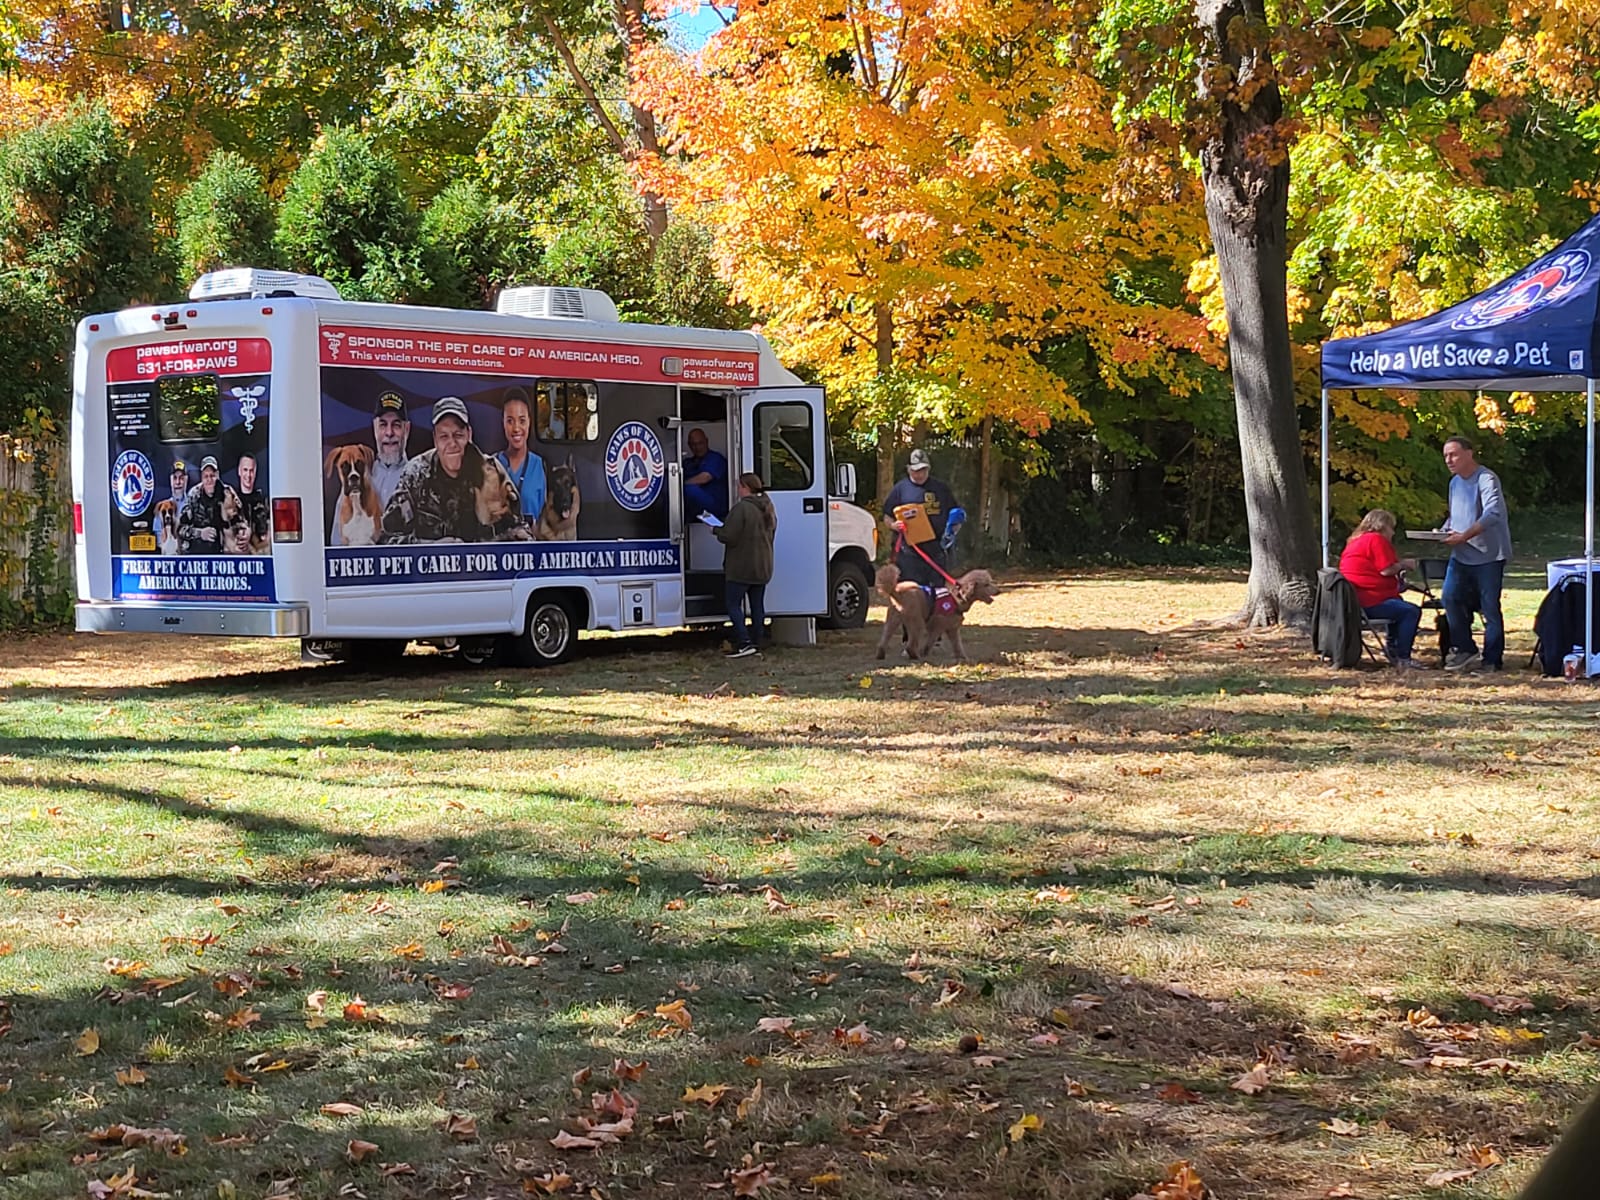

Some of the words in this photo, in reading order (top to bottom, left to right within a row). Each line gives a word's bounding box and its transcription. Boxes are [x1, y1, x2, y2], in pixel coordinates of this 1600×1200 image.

[136, 340, 237, 360] pawsofwar.org
[348, 336, 414, 350] SPONSOR
[417, 340, 441, 352] THE
[445, 342, 469, 354] PET
[472, 344, 506, 356] CARE
[509, 346, 525, 357] OF
[528, 348, 546, 359] AN
[548, 350, 608, 363] AMERICAN
[610, 354, 643, 366] HERO.
[349, 350, 373, 361] This
[374, 352, 411, 363] vehicle
[412, 355, 437, 364] runs
[438, 357, 451, 365] on
[453, 357, 505, 368] donations.
[1350, 348, 1391, 377] Help
[1393, 352, 1405, 371] a
[1409, 344, 1441, 369] Vet
[1444, 342, 1489, 367] Save
[1493, 347, 1510, 366] a
[1513, 341, 1551, 366] Pet
[137, 356, 238, 374] 631-FOR-PAWS
[683, 358, 754, 371] pawsofwar.org
[683, 369, 755, 382] 631-FOR-PAWS
[609, 427, 630, 456] PAWS
[630, 425, 643, 437] OF
[644, 429, 660, 457] WAR
[114, 454, 129, 478] PAWS
[122, 560, 151, 575] FREE
[154, 560, 176, 574] PET
[178, 560, 208, 575] CARE
[211, 560, 235, 575] FOR
[239, 560, 265, 575] OUR
[328, 556, 375, 577] FREE
[379, 556, 413, 575] PET
[417, 554, 461, 574] CARE
[466, 553, 498, 572] FOR
[501, 552, 536, 571] OUR
[538, 550, 615, 570] AMERICAN
[619, 549, 678, 567] HEROES.
[138, 576, 197, 590] AMERICAN
[201, 576, 252, 591] HEROES.
